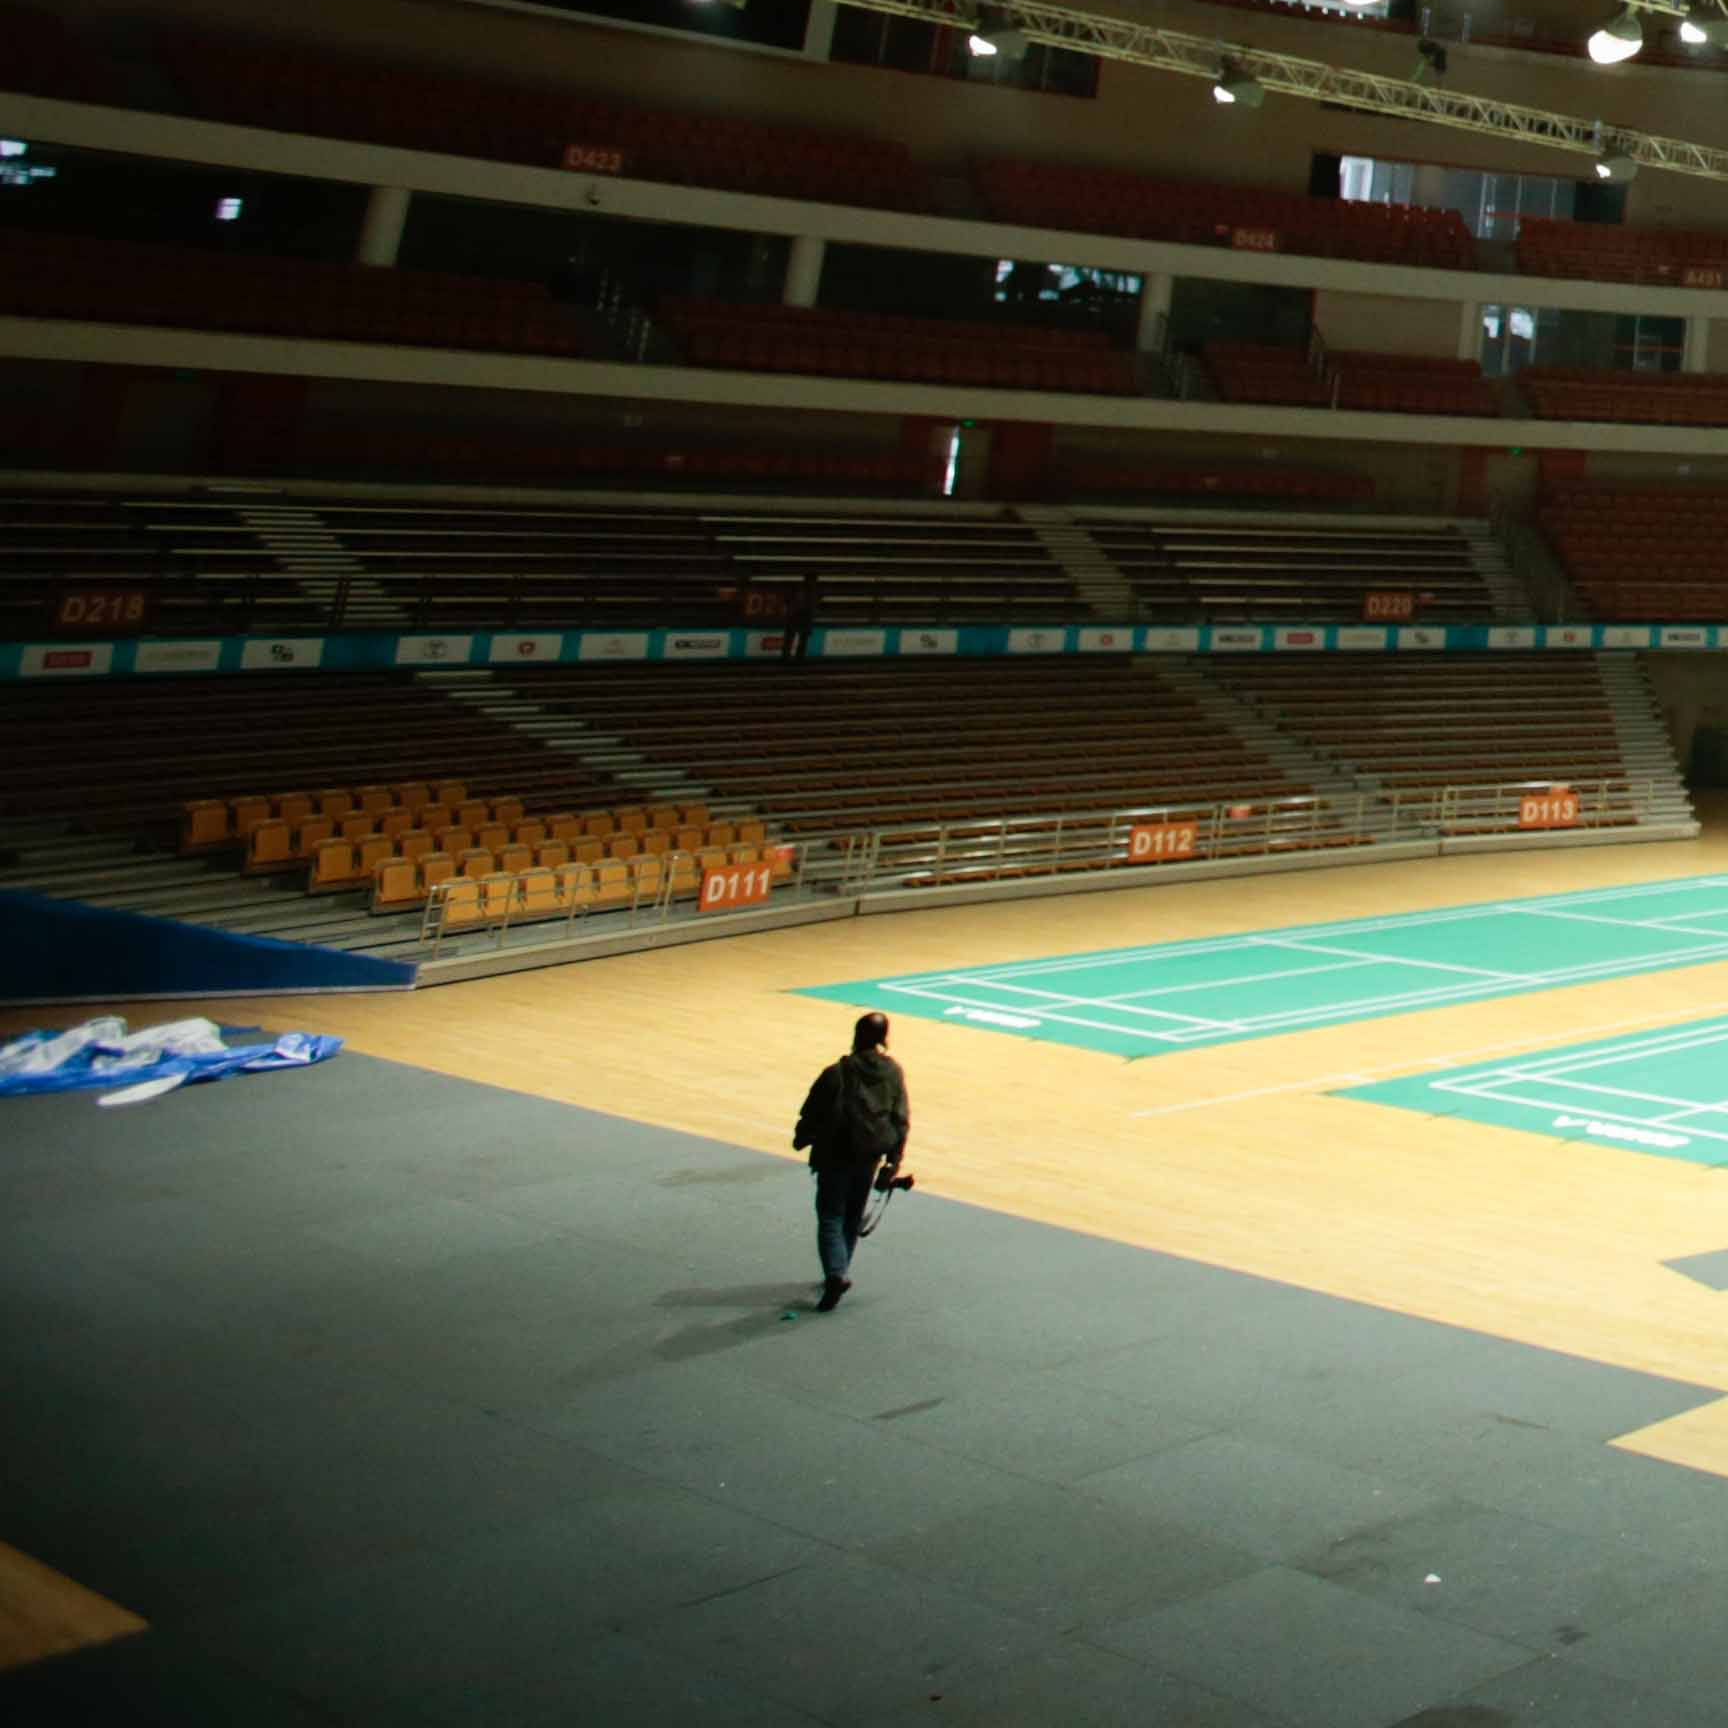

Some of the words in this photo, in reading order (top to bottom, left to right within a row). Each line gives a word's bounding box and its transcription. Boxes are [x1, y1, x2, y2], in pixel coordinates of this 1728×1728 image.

[1523, 800, 1575, 822] D113
[1132, 828, 1192, 856] D112
[707, 869, 770, 903] D111
